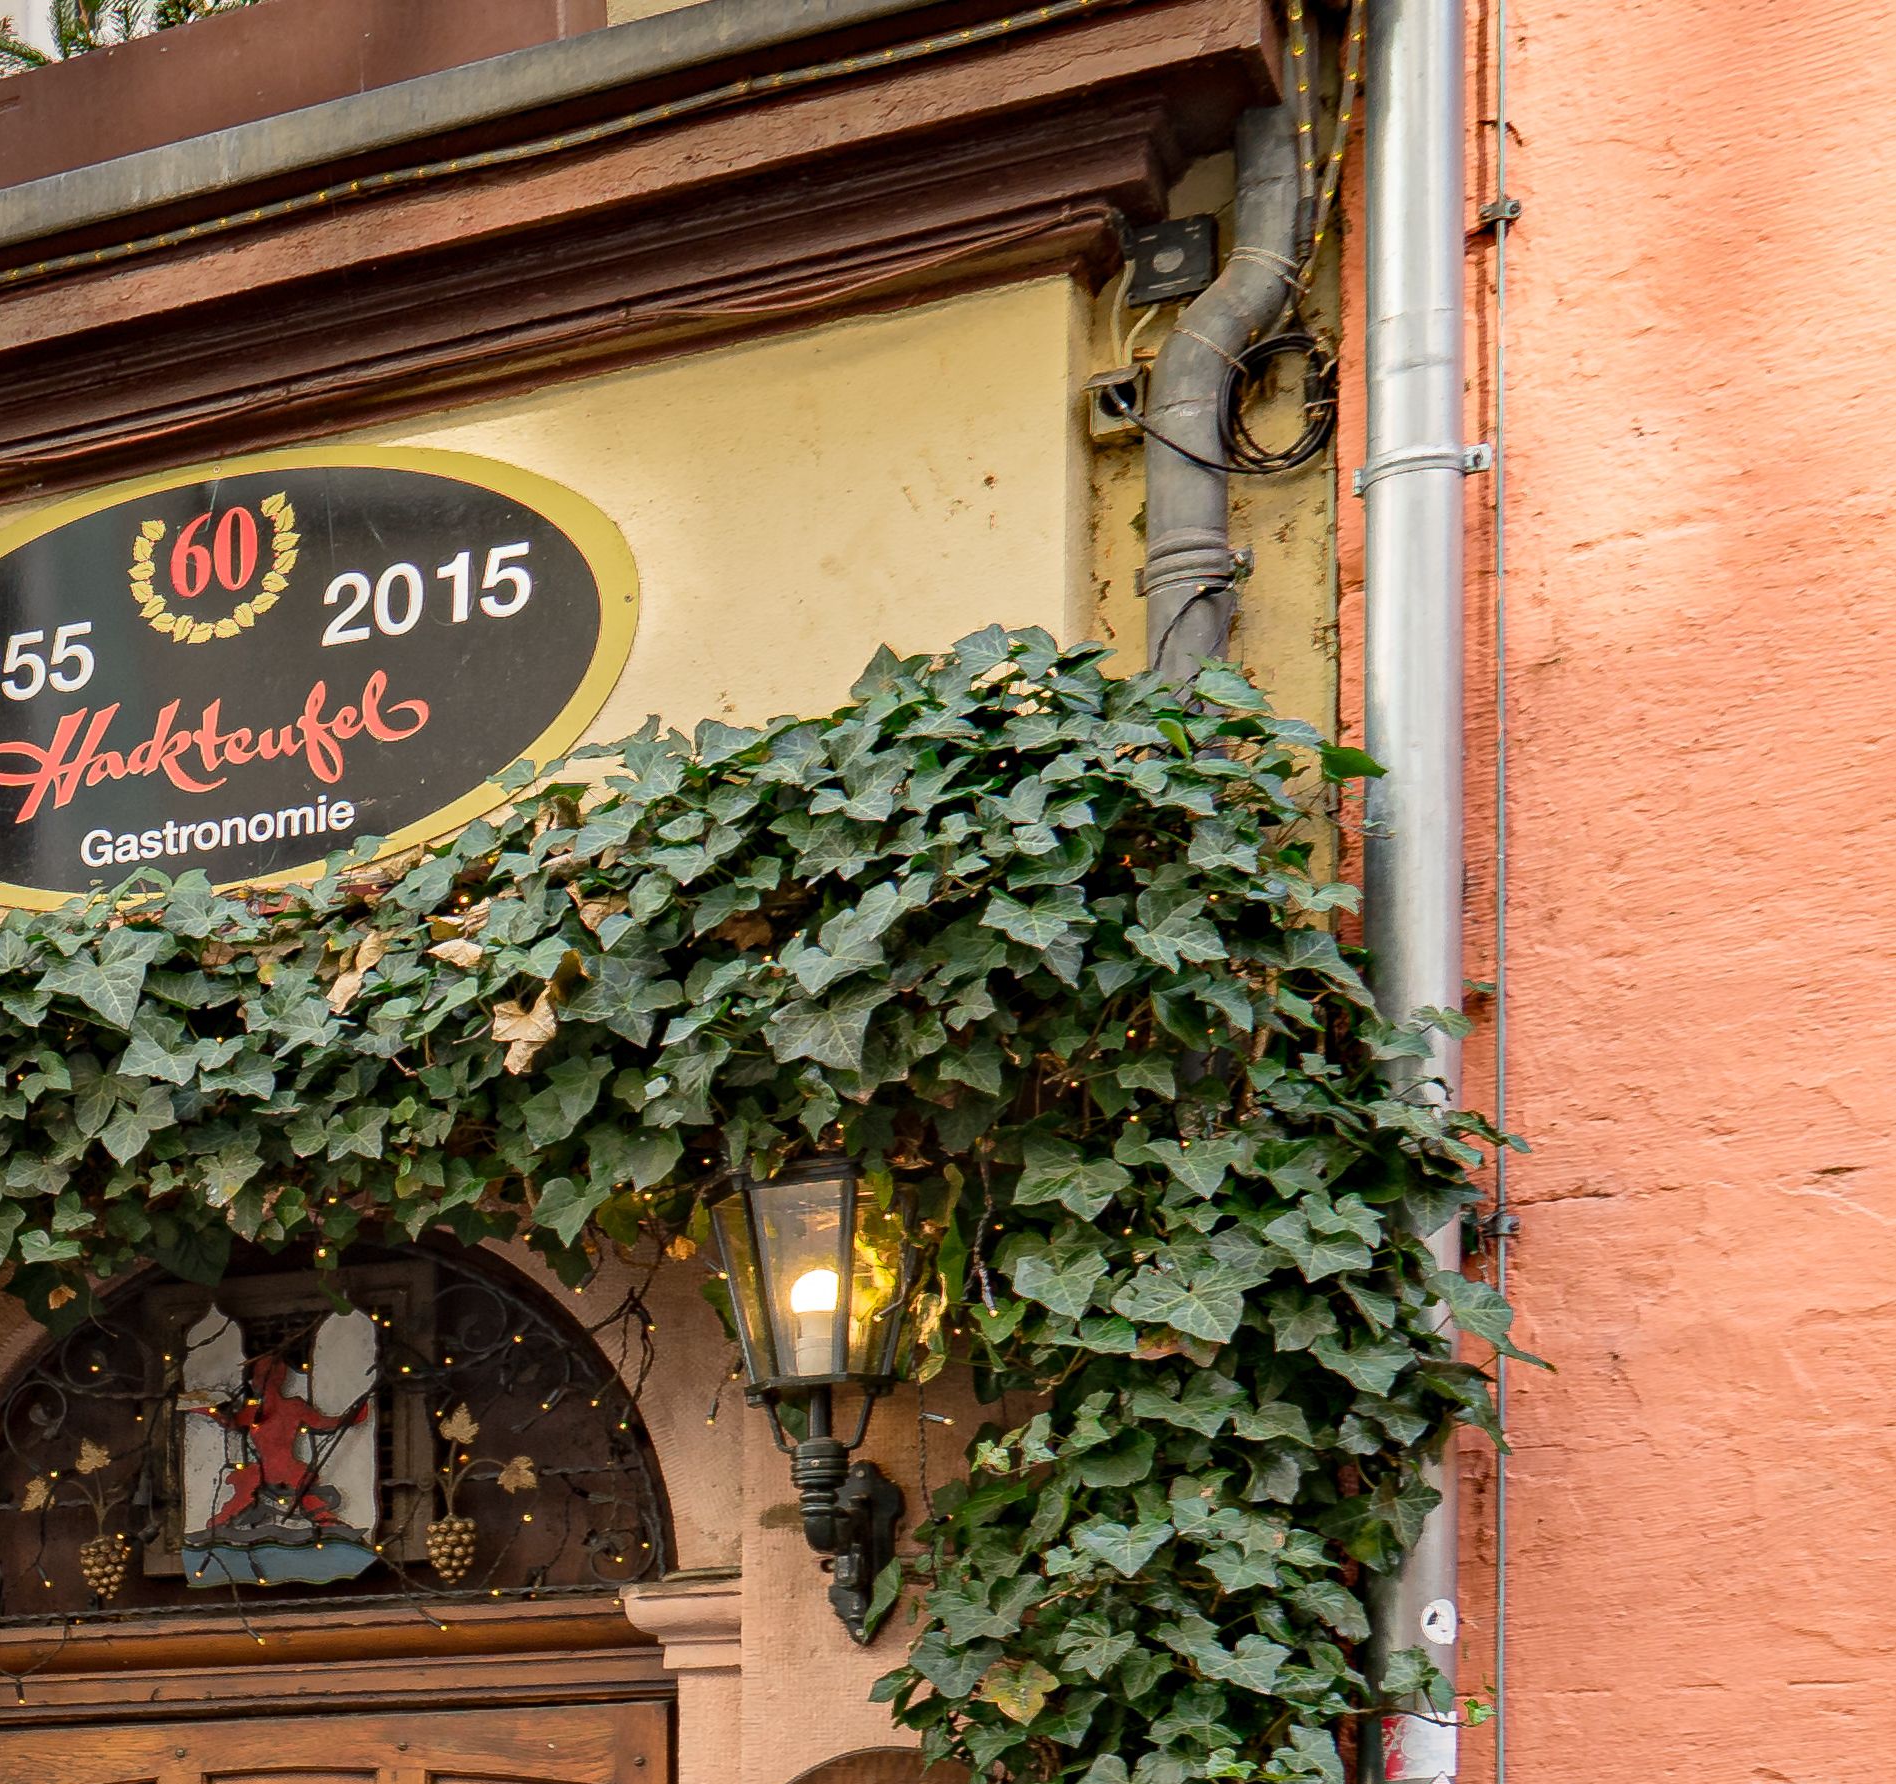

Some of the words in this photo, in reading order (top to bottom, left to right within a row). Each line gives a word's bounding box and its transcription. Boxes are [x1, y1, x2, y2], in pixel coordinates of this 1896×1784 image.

[170, 506, 259, 598] 60
[321, 541, 532, 648] 2015
[80, 795, 356, 869] Gastronomie
